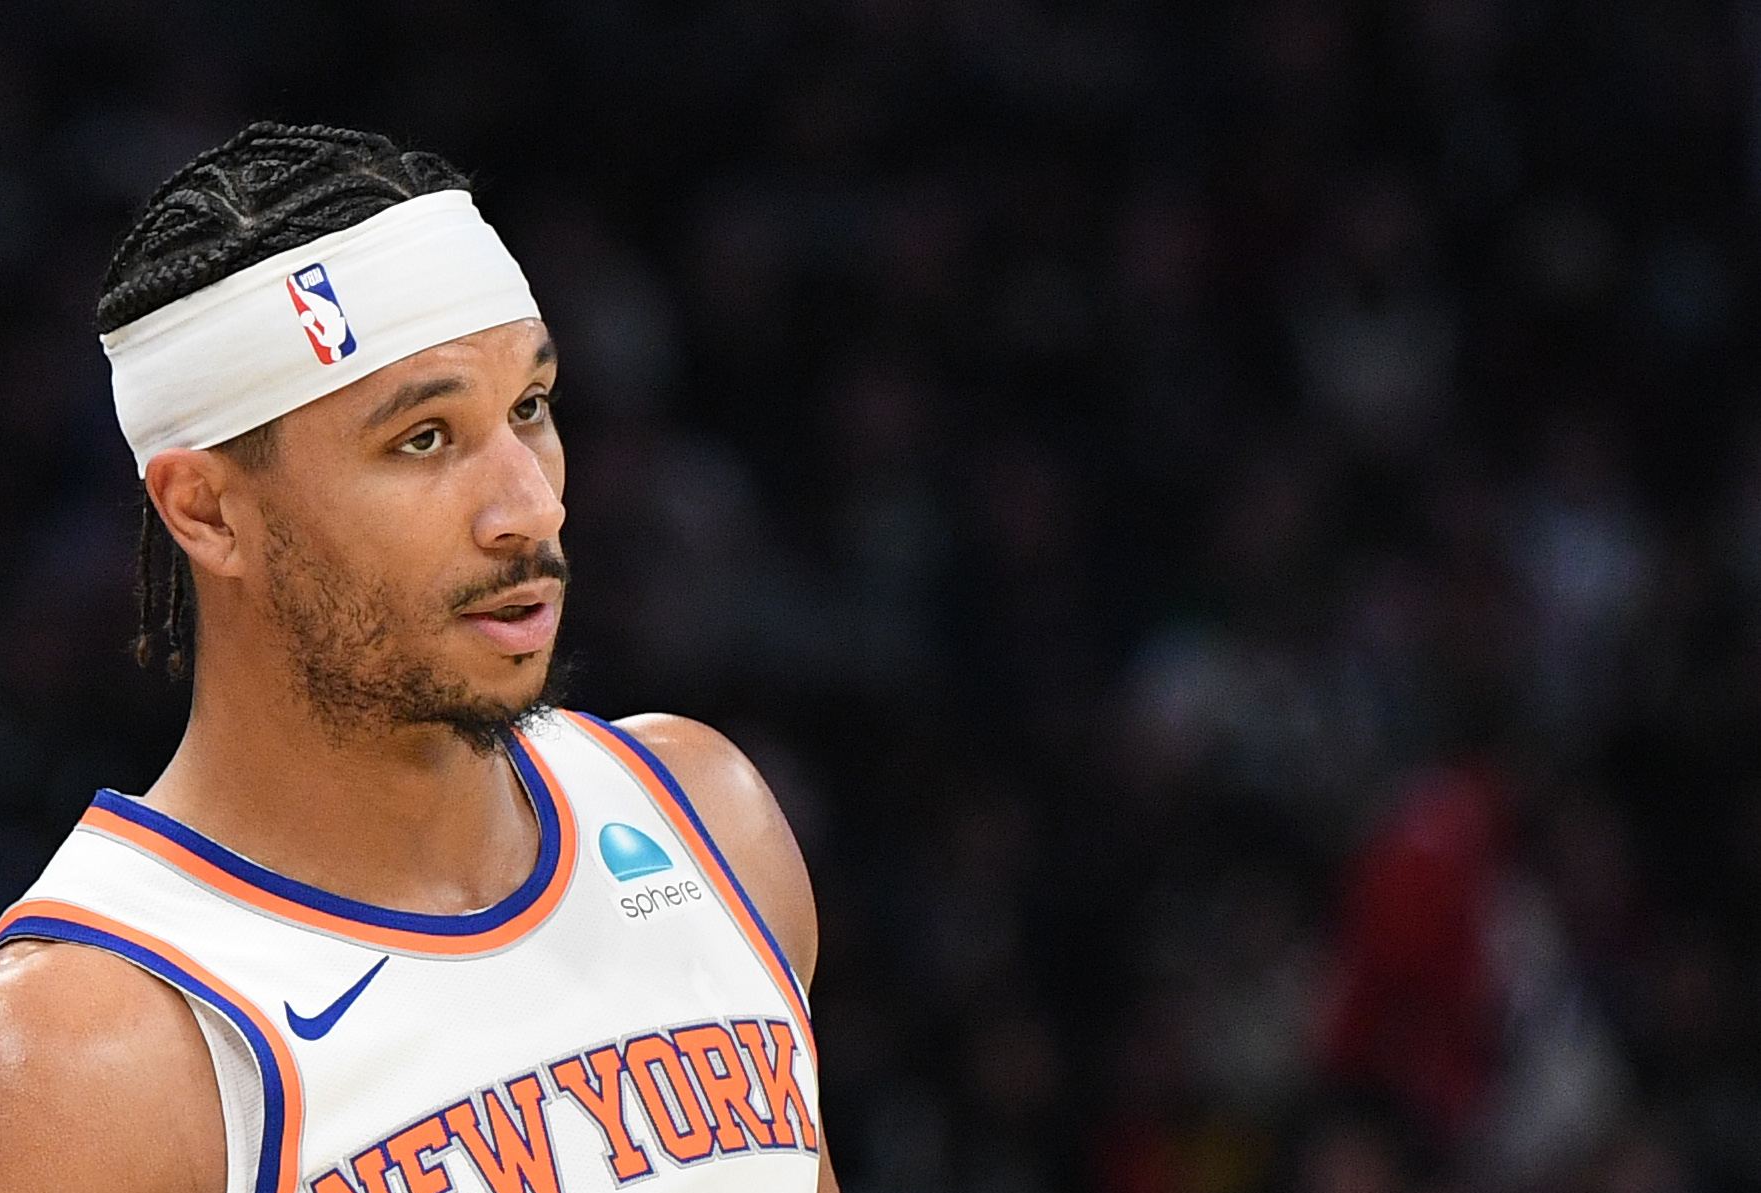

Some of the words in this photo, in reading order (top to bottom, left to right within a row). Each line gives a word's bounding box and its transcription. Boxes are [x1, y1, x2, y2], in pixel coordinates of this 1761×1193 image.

[299, 266, 325, 290] NBA
[620, 880, 702, 920] sphere
[541, 1014, 819, 1190] YORK
